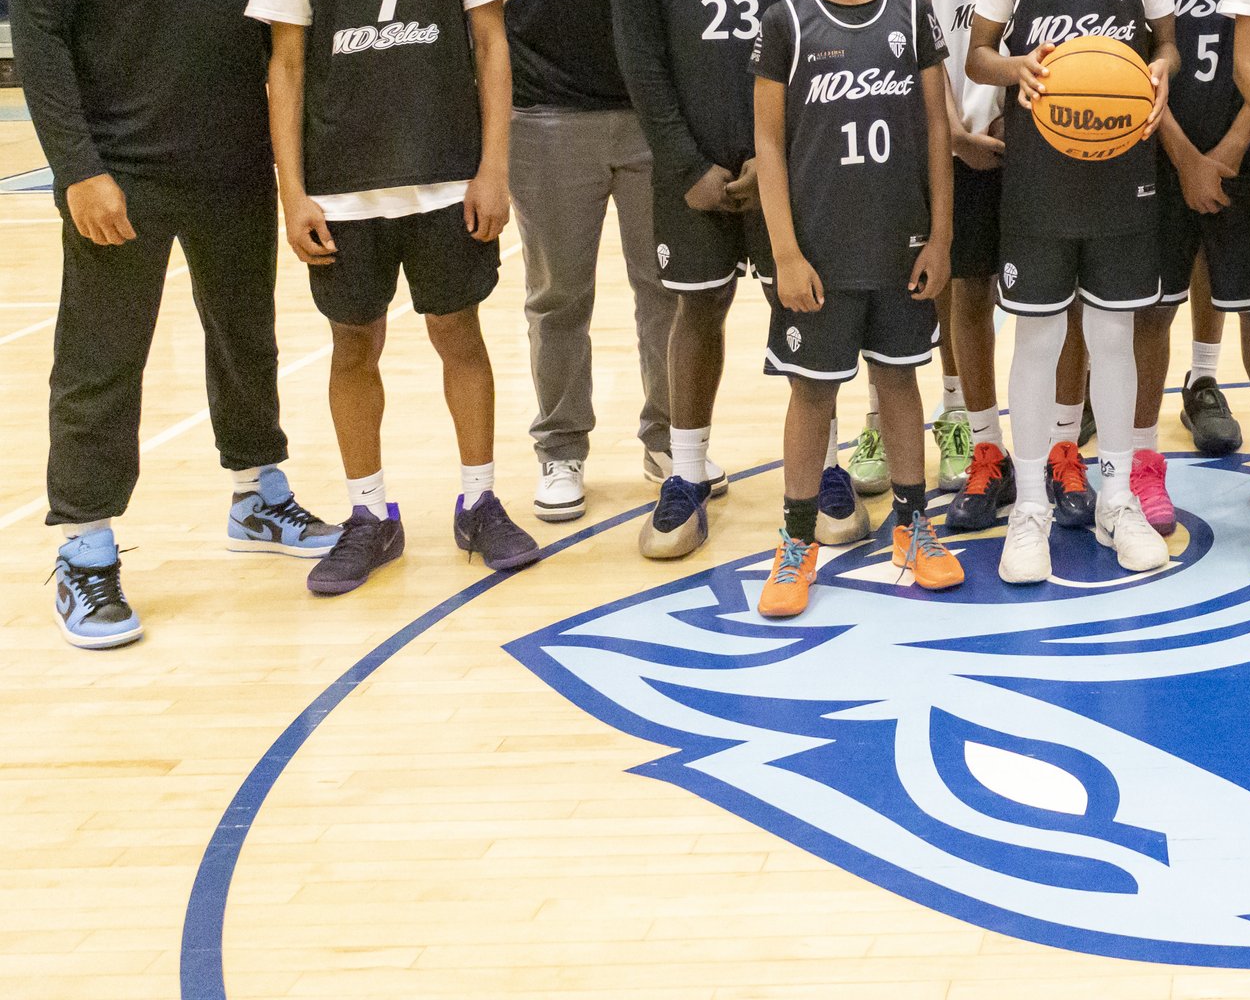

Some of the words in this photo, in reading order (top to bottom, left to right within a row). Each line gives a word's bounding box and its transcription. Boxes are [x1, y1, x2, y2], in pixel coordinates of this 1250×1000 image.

[1194, 34, 1220, 83] 5
[1049, 103, 1132, 131] Wilson
[840, 119, 891, 166] 10
